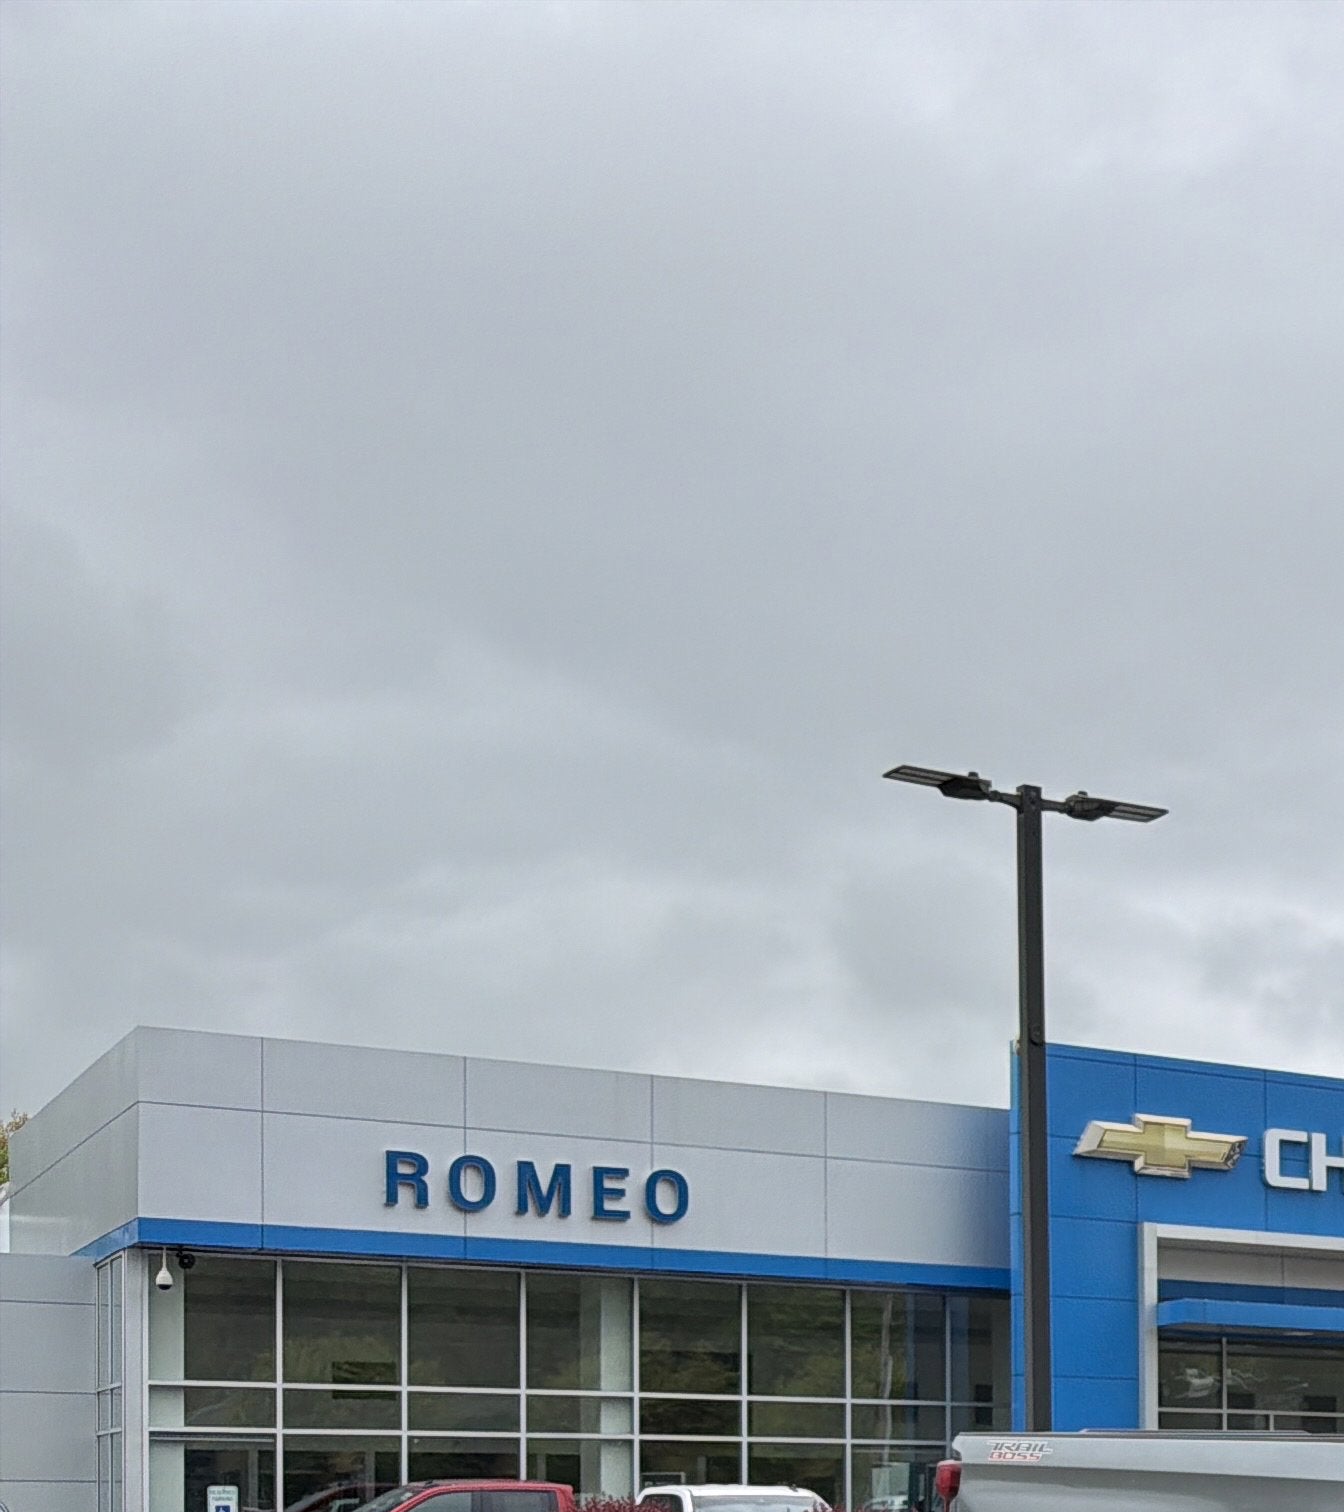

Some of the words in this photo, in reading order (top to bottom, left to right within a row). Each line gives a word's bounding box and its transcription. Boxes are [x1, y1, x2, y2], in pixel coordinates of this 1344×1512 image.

[384, 1150, 690, 1225] ROMEO
[986, 1441, 1053, 1453] TRAIL
[988, 1452, 1042, 1461] BOSS
